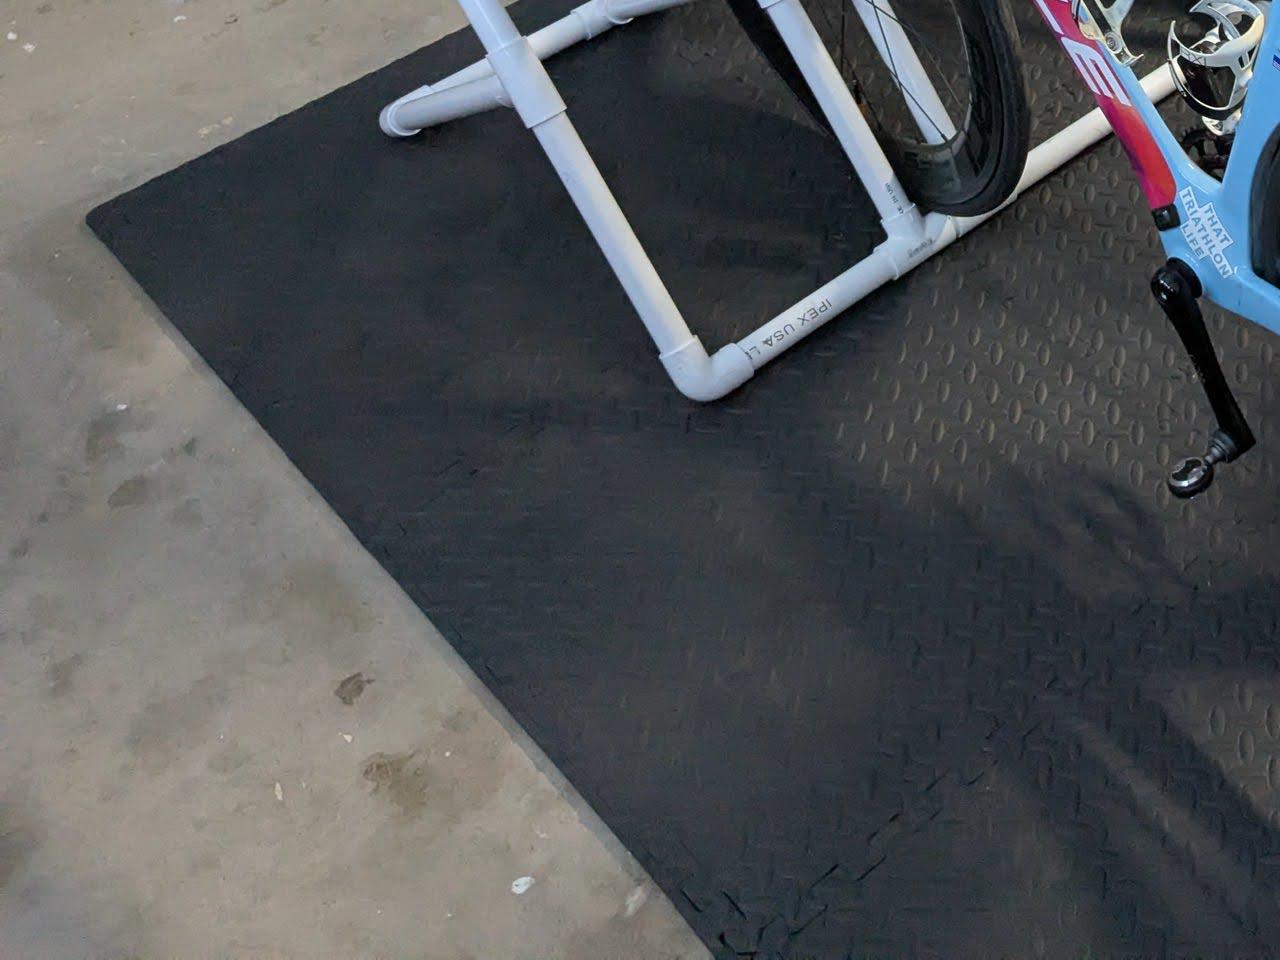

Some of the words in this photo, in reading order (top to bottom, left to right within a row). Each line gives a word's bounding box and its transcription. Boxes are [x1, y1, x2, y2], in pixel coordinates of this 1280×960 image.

[1181, 224, 1205, 257] LIFE
[1182, 188, 1232, 277] TRIATHLON
[1203, 204, 1231, 244] THAT
[794, 297, 834, 327] IPEX
[760, 321, 797, 349] USA
